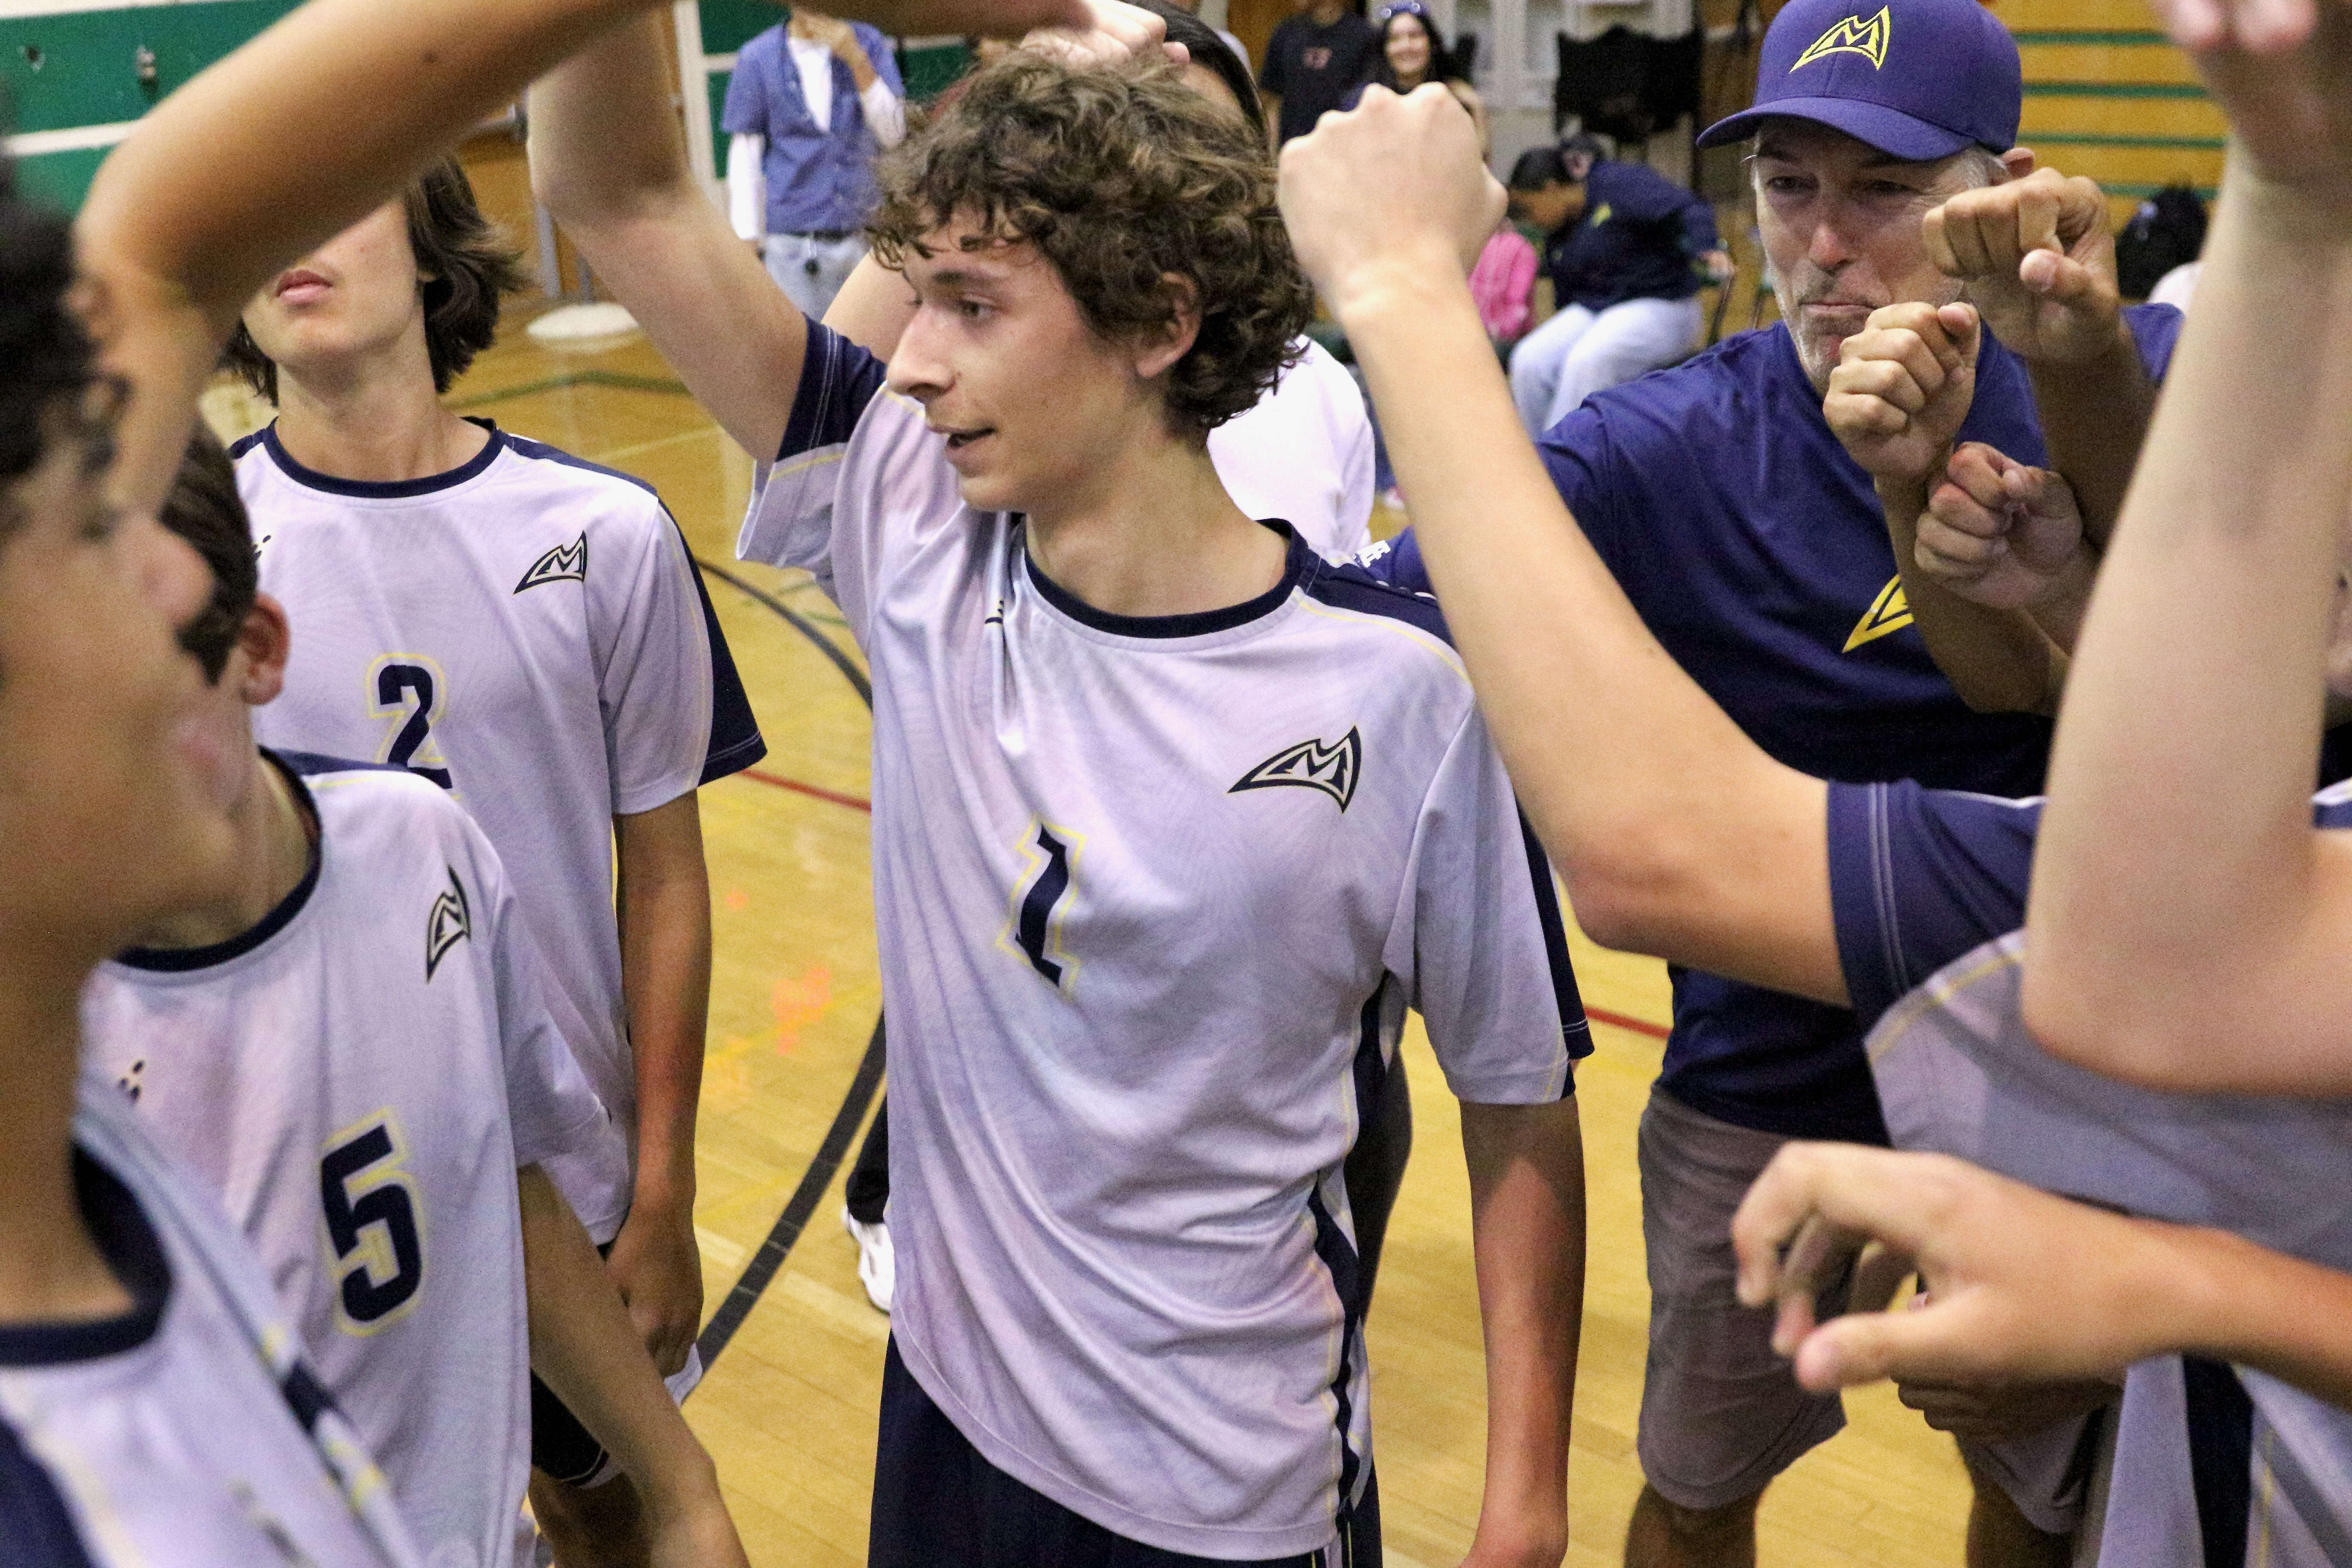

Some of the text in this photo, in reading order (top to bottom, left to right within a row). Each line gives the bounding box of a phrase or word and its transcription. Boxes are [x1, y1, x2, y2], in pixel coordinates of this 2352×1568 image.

[367, 653, 453, 790] 2
[999, 818, 1084, 998] 1
[317, 1109, 425, 1334] 5
